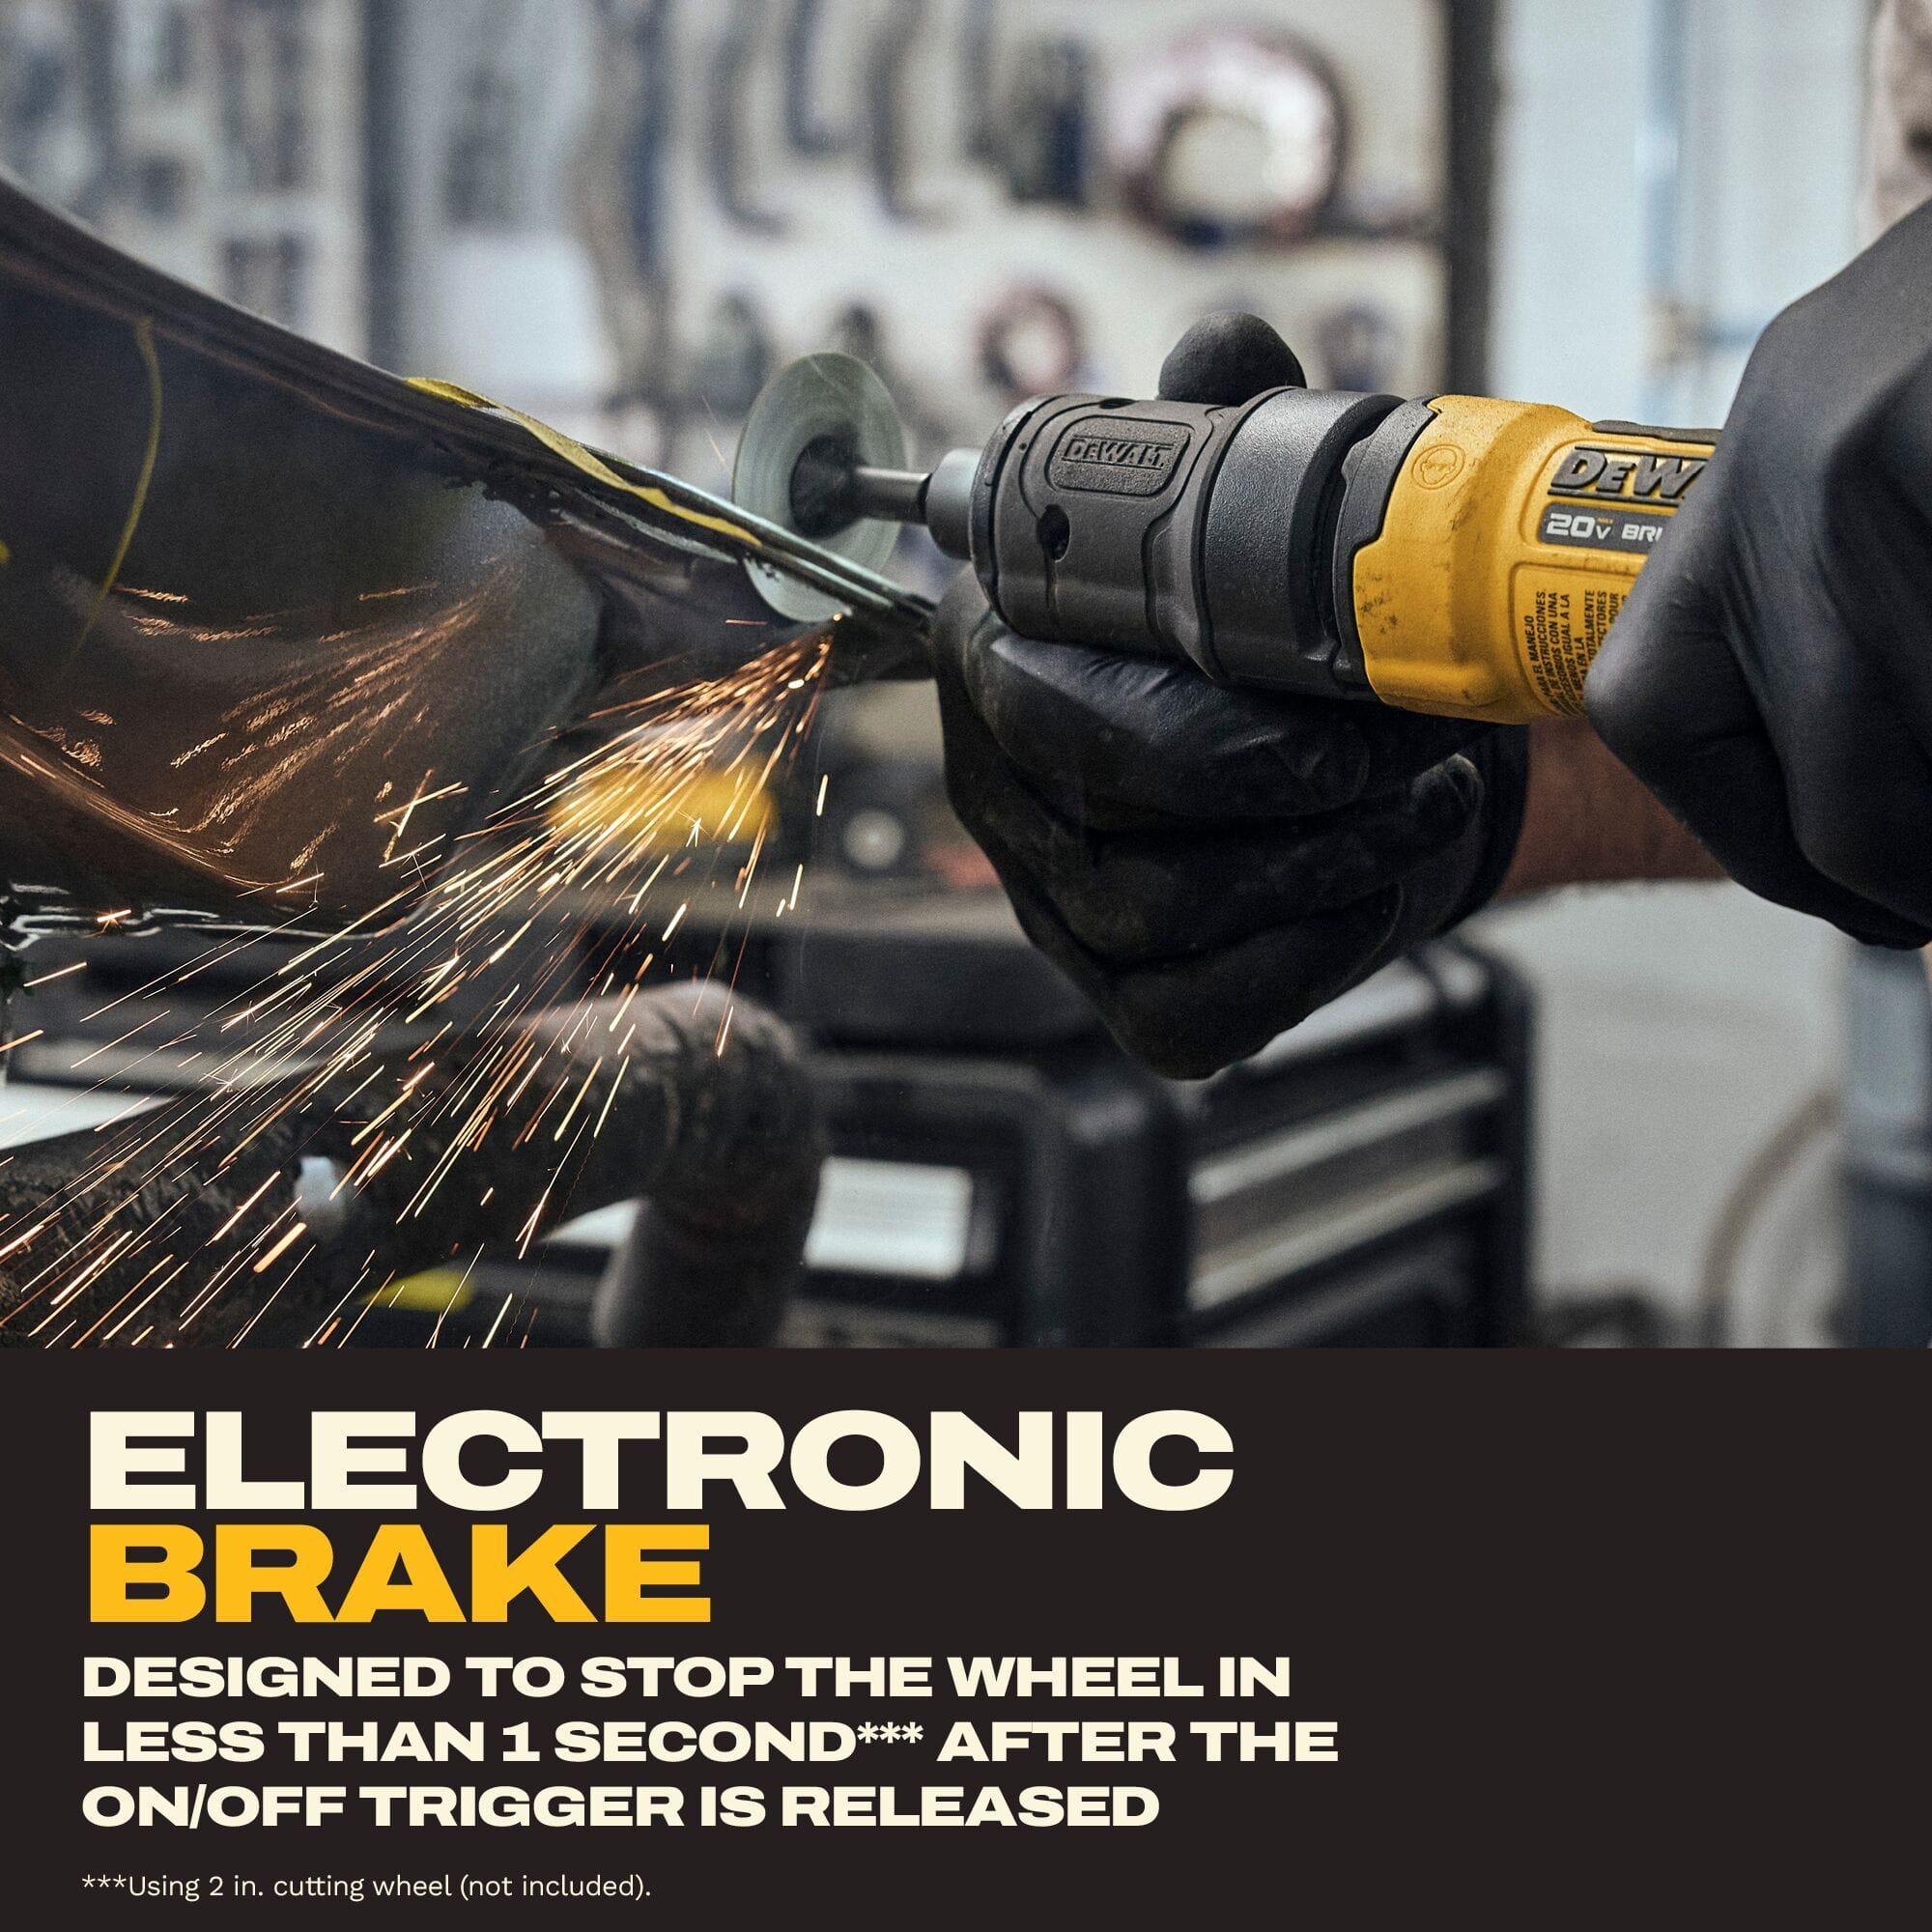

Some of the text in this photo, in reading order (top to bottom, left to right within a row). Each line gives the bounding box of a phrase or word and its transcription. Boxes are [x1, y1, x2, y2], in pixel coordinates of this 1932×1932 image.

[1550, 449, 1706, 498] DEW
[1548, 593, 1558, 618] UNA
[1560, 595, 1570, 609] LA
[1524, 616, 1539, 662] MANEJO
[1549, 622, 1560, 644] CON
[1561, 624, 1574, 655] IGUAL
[1575, 639, 1584, 650] LA
[1577, 654, 1587, 667] EN
